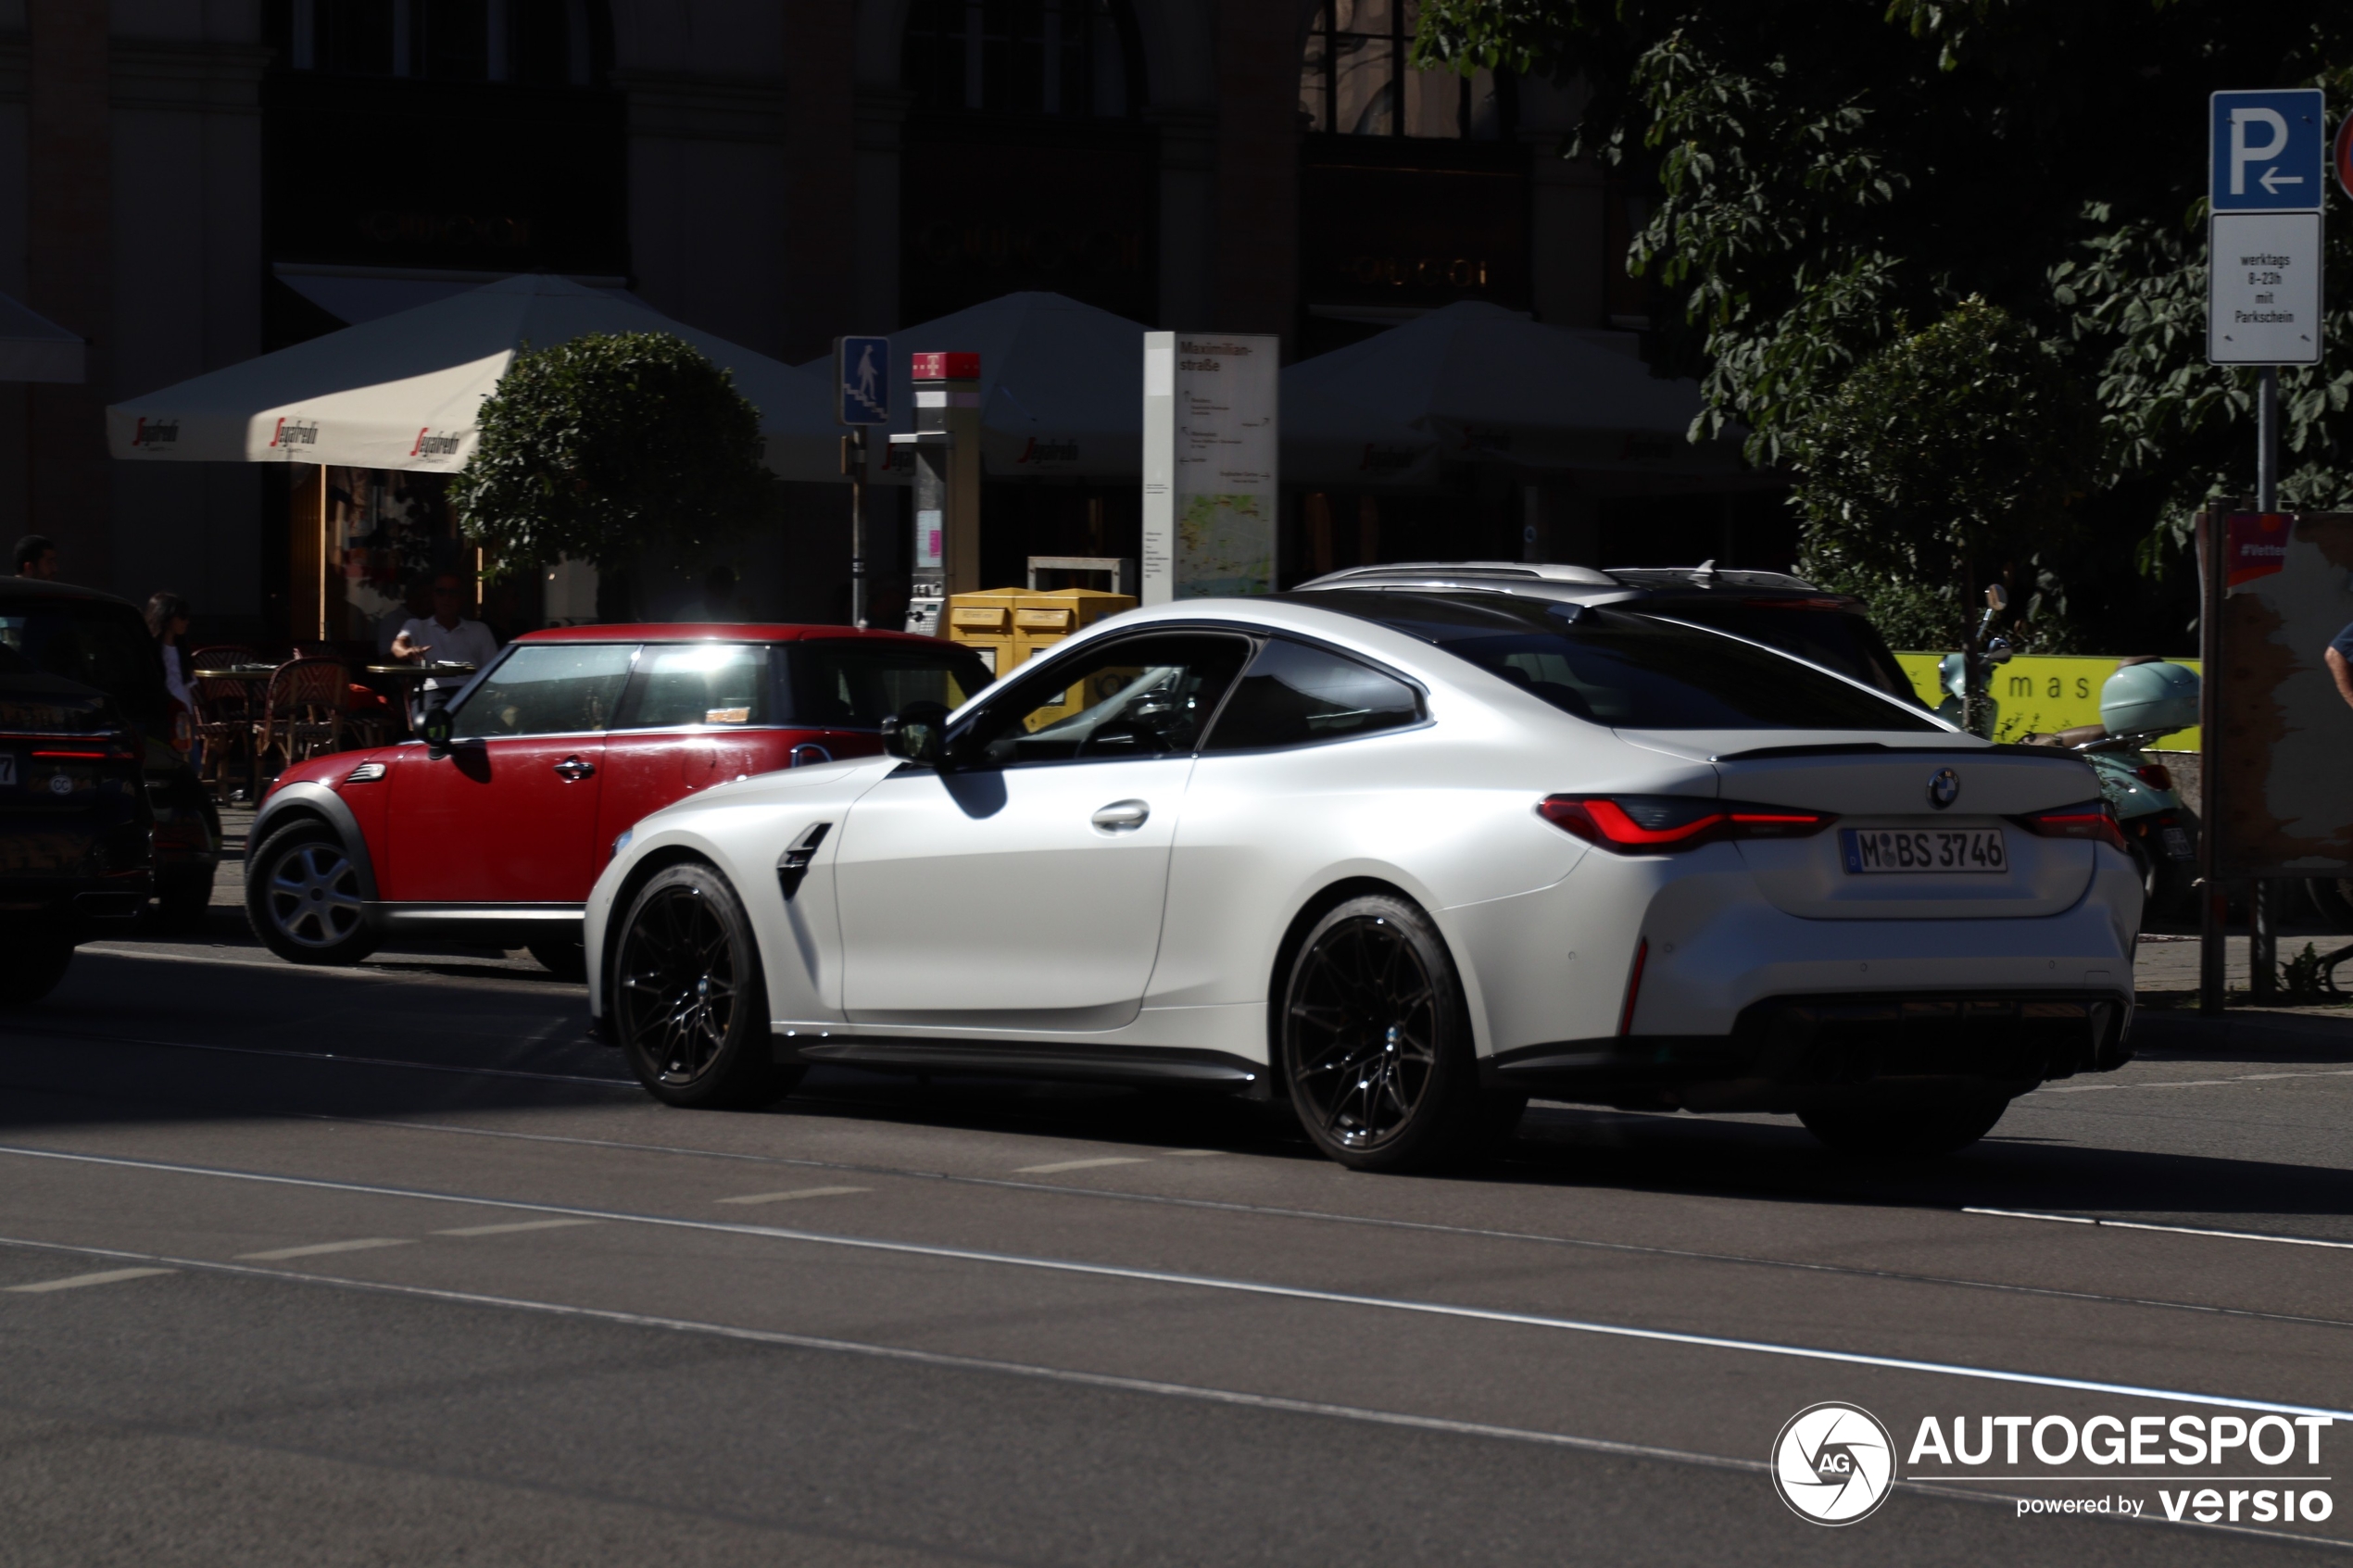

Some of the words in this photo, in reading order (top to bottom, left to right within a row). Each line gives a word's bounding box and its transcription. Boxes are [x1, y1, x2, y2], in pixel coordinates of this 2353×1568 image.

[2230, 107, 2289, 194] P
[2240, 254, 2291, 269] werktags
[2248, 272, 2282, 285] 8-23h
[2255, 291, 2274, 304] mit
[2234, 310, 2294, 324] Parkschein
[1180, 341, 1252, 356] Maximilian-
[1179, 358, 1220, 371] straße
[1937, 834, 2003, 867] 3746
